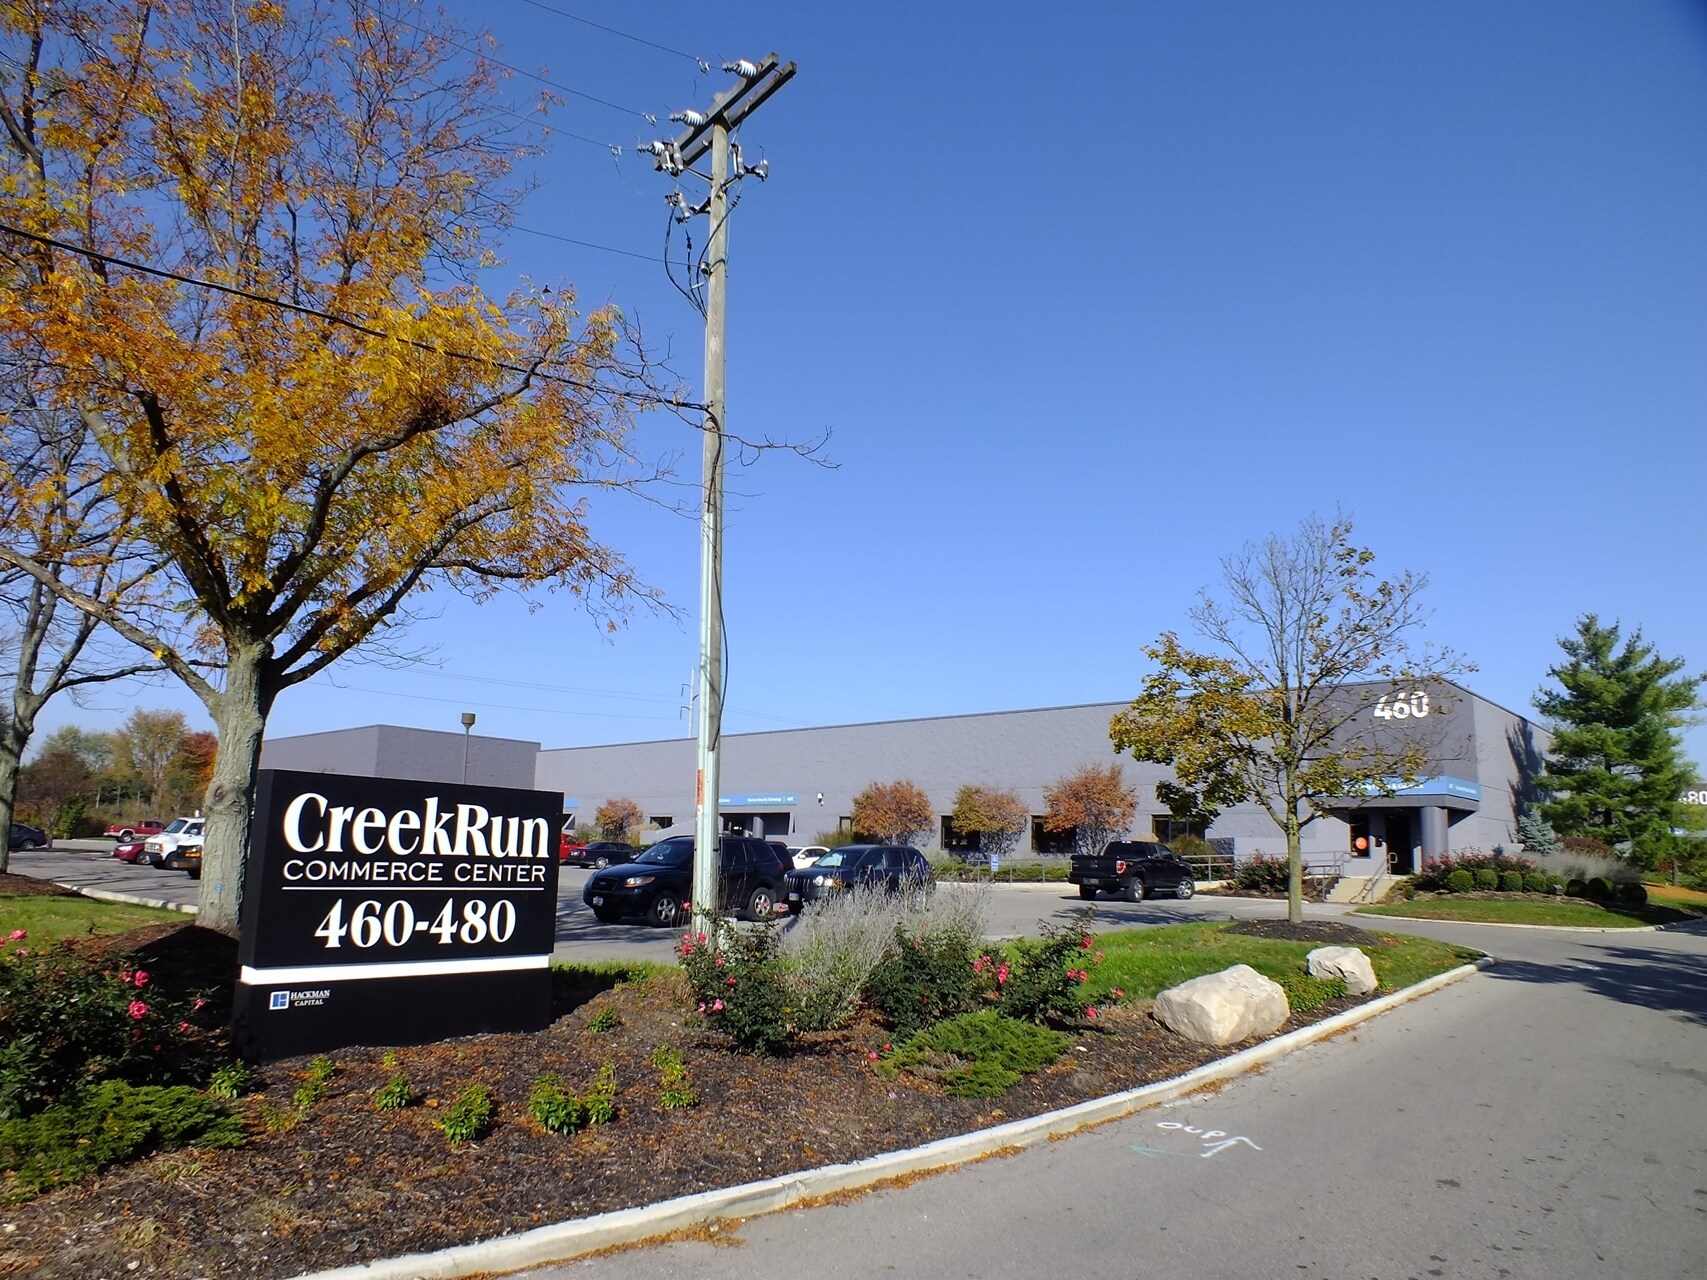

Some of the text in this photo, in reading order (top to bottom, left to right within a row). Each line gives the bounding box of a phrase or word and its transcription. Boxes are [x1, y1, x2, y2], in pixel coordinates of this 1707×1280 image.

[1374, 691, 1429, 720] 460
[283, 792, 550, 858] CreekRun
[283, 860, 545, 882] COMMERCE CENTER
[314, 898, 517, 948] 460-480
[290, 990, 331, 1000] HACKMAN
[294, 999, 324, 1007] CAPITAL
